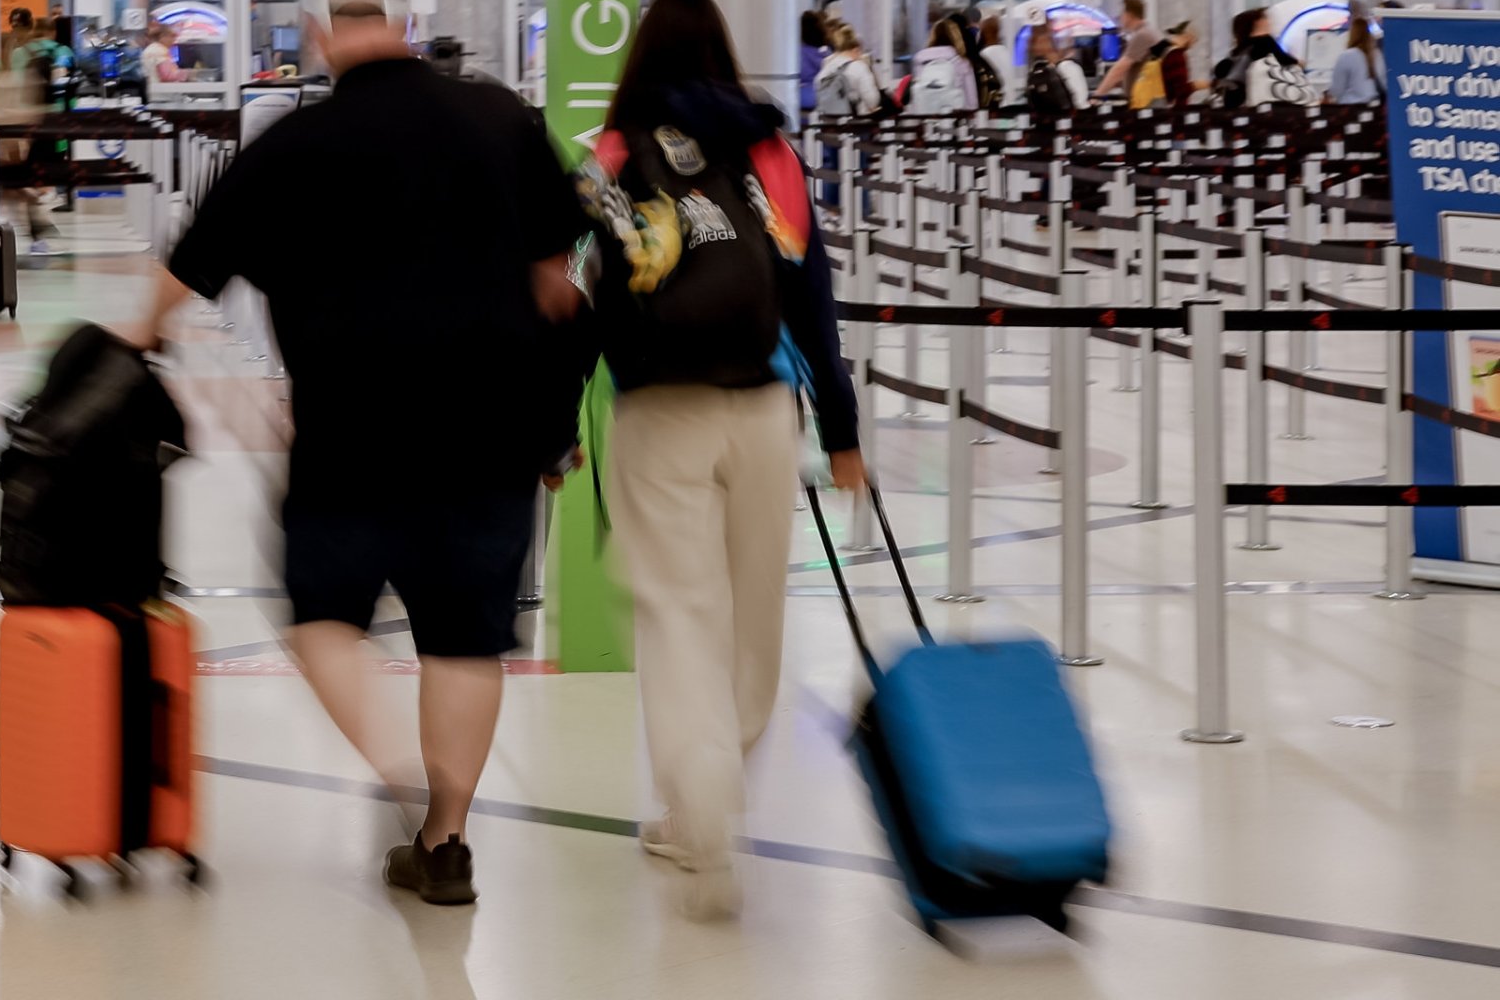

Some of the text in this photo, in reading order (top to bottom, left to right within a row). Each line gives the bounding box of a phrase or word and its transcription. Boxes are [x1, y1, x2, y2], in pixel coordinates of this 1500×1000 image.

[1409, 39, 1465, 64] Now
[1397, 73, 1454, 99] your
[1406, 102, 1434, 128] to
[1408, 135, 1500, 163] and use
[1418, 166, 1469, 193] TSA
[688, 229, 738, 250] adidas
